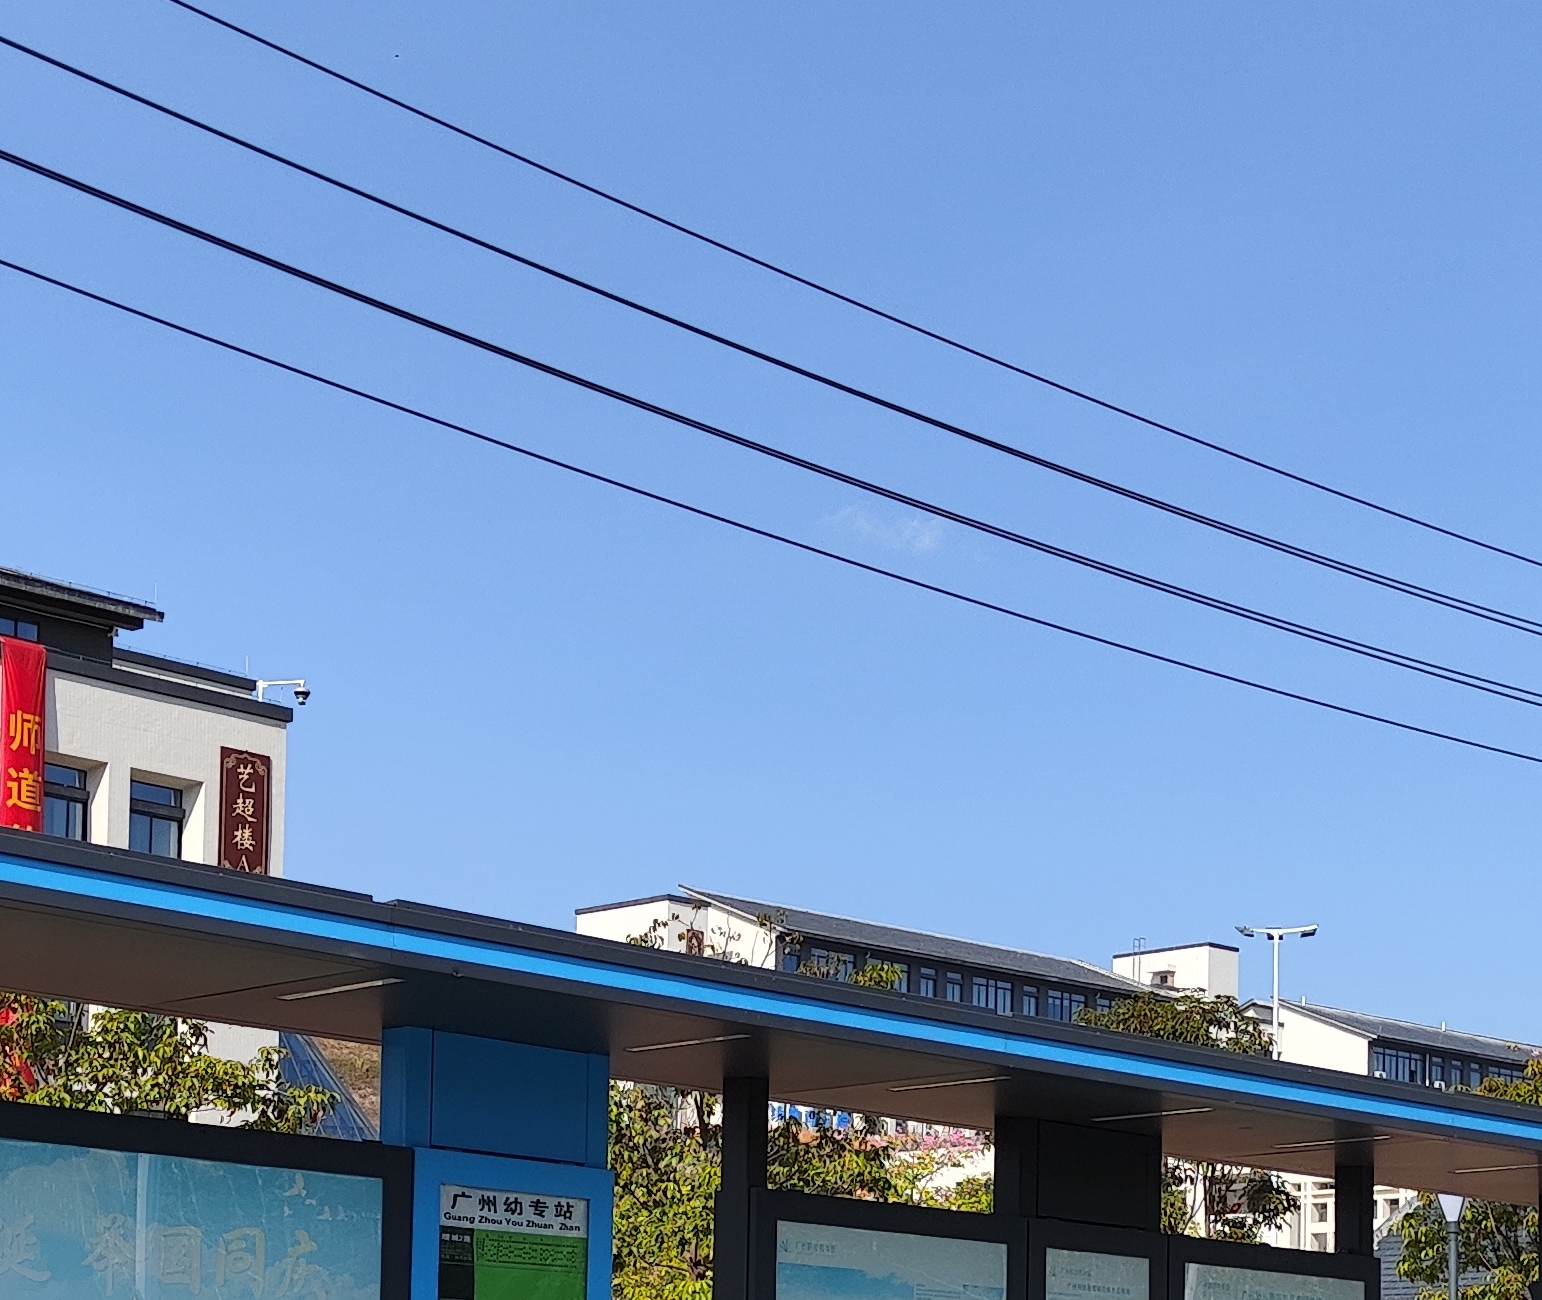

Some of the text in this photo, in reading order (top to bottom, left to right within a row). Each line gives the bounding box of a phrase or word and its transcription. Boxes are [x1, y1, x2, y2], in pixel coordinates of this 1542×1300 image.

[5, 709, 42, 832] 师道
[450, 1191, 575, 1221] 广州幼专站
[443, 1211, 581, 1232] Guang Zhou You Zhuan Zhan
